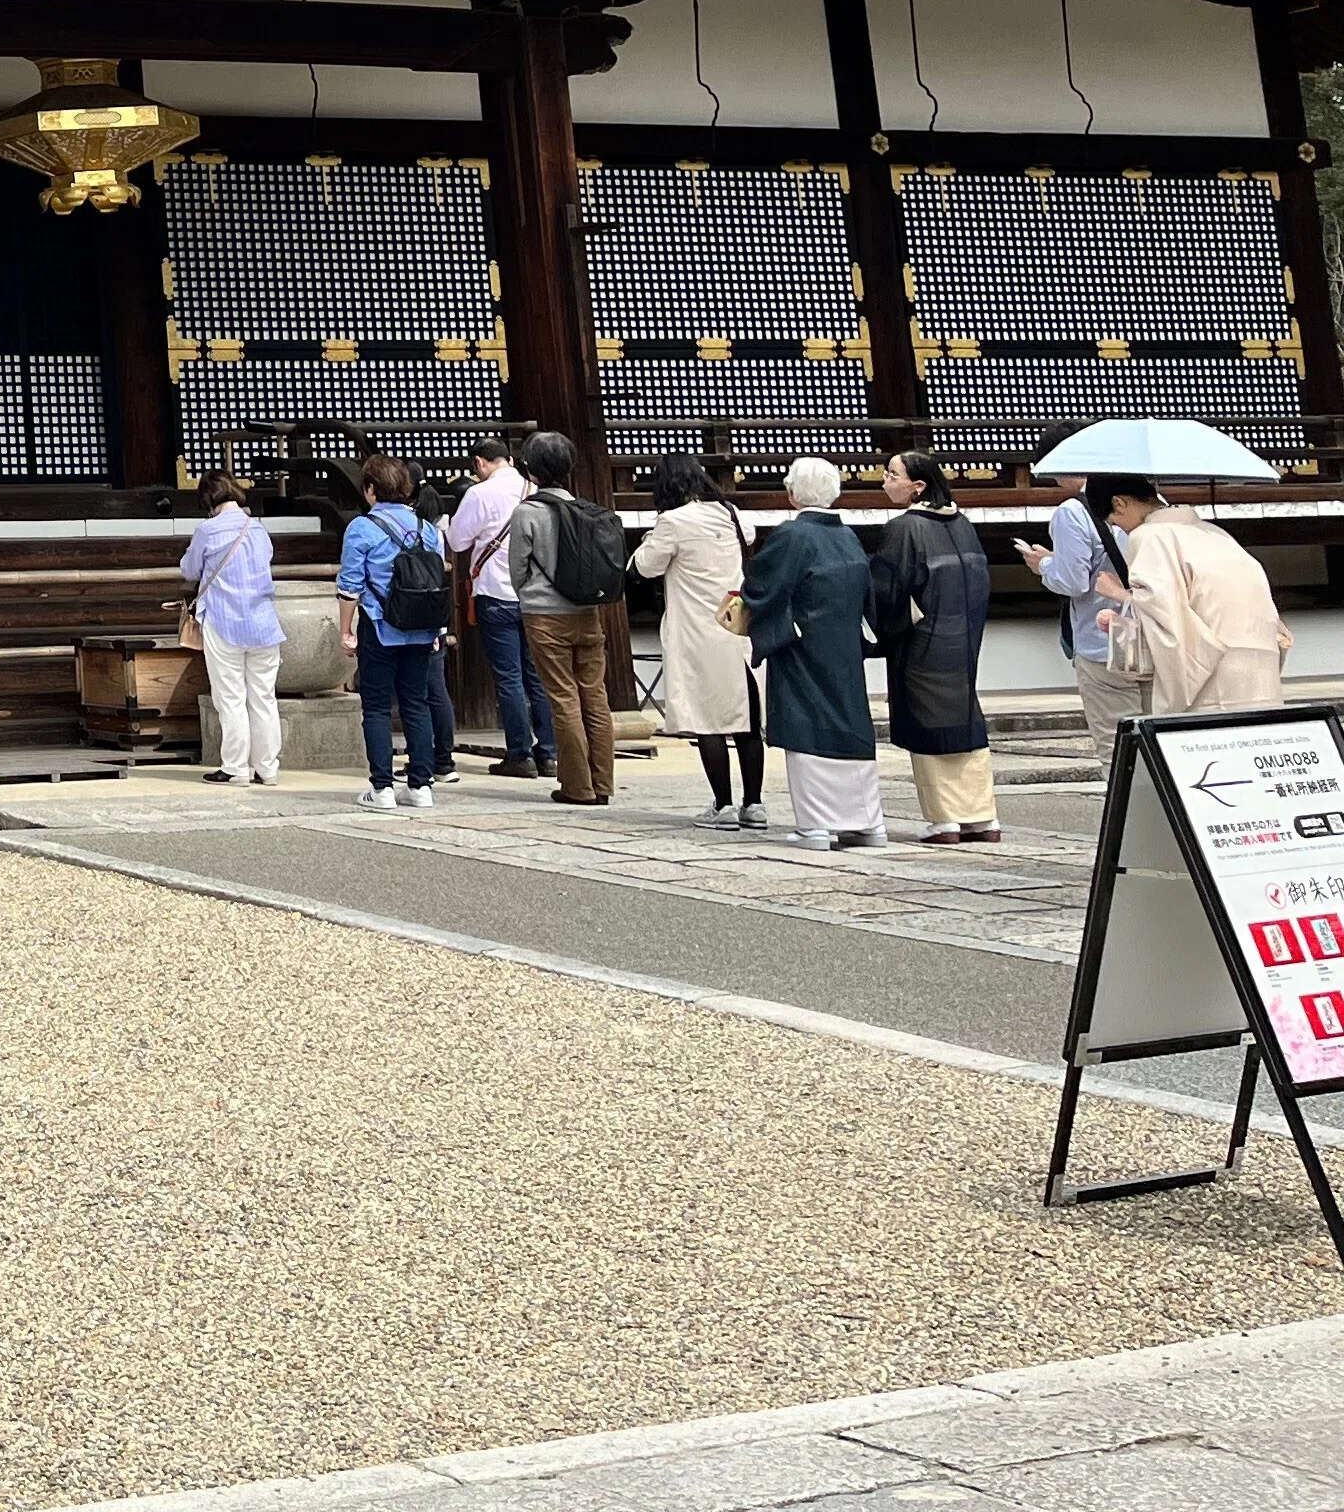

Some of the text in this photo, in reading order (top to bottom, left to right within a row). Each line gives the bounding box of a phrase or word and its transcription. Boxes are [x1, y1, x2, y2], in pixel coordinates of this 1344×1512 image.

[1181, 745, 1194, 753] The
[1254, 751, 1320, 769] OMURO88
[1286, 876, 1344, 904] 御朱印
